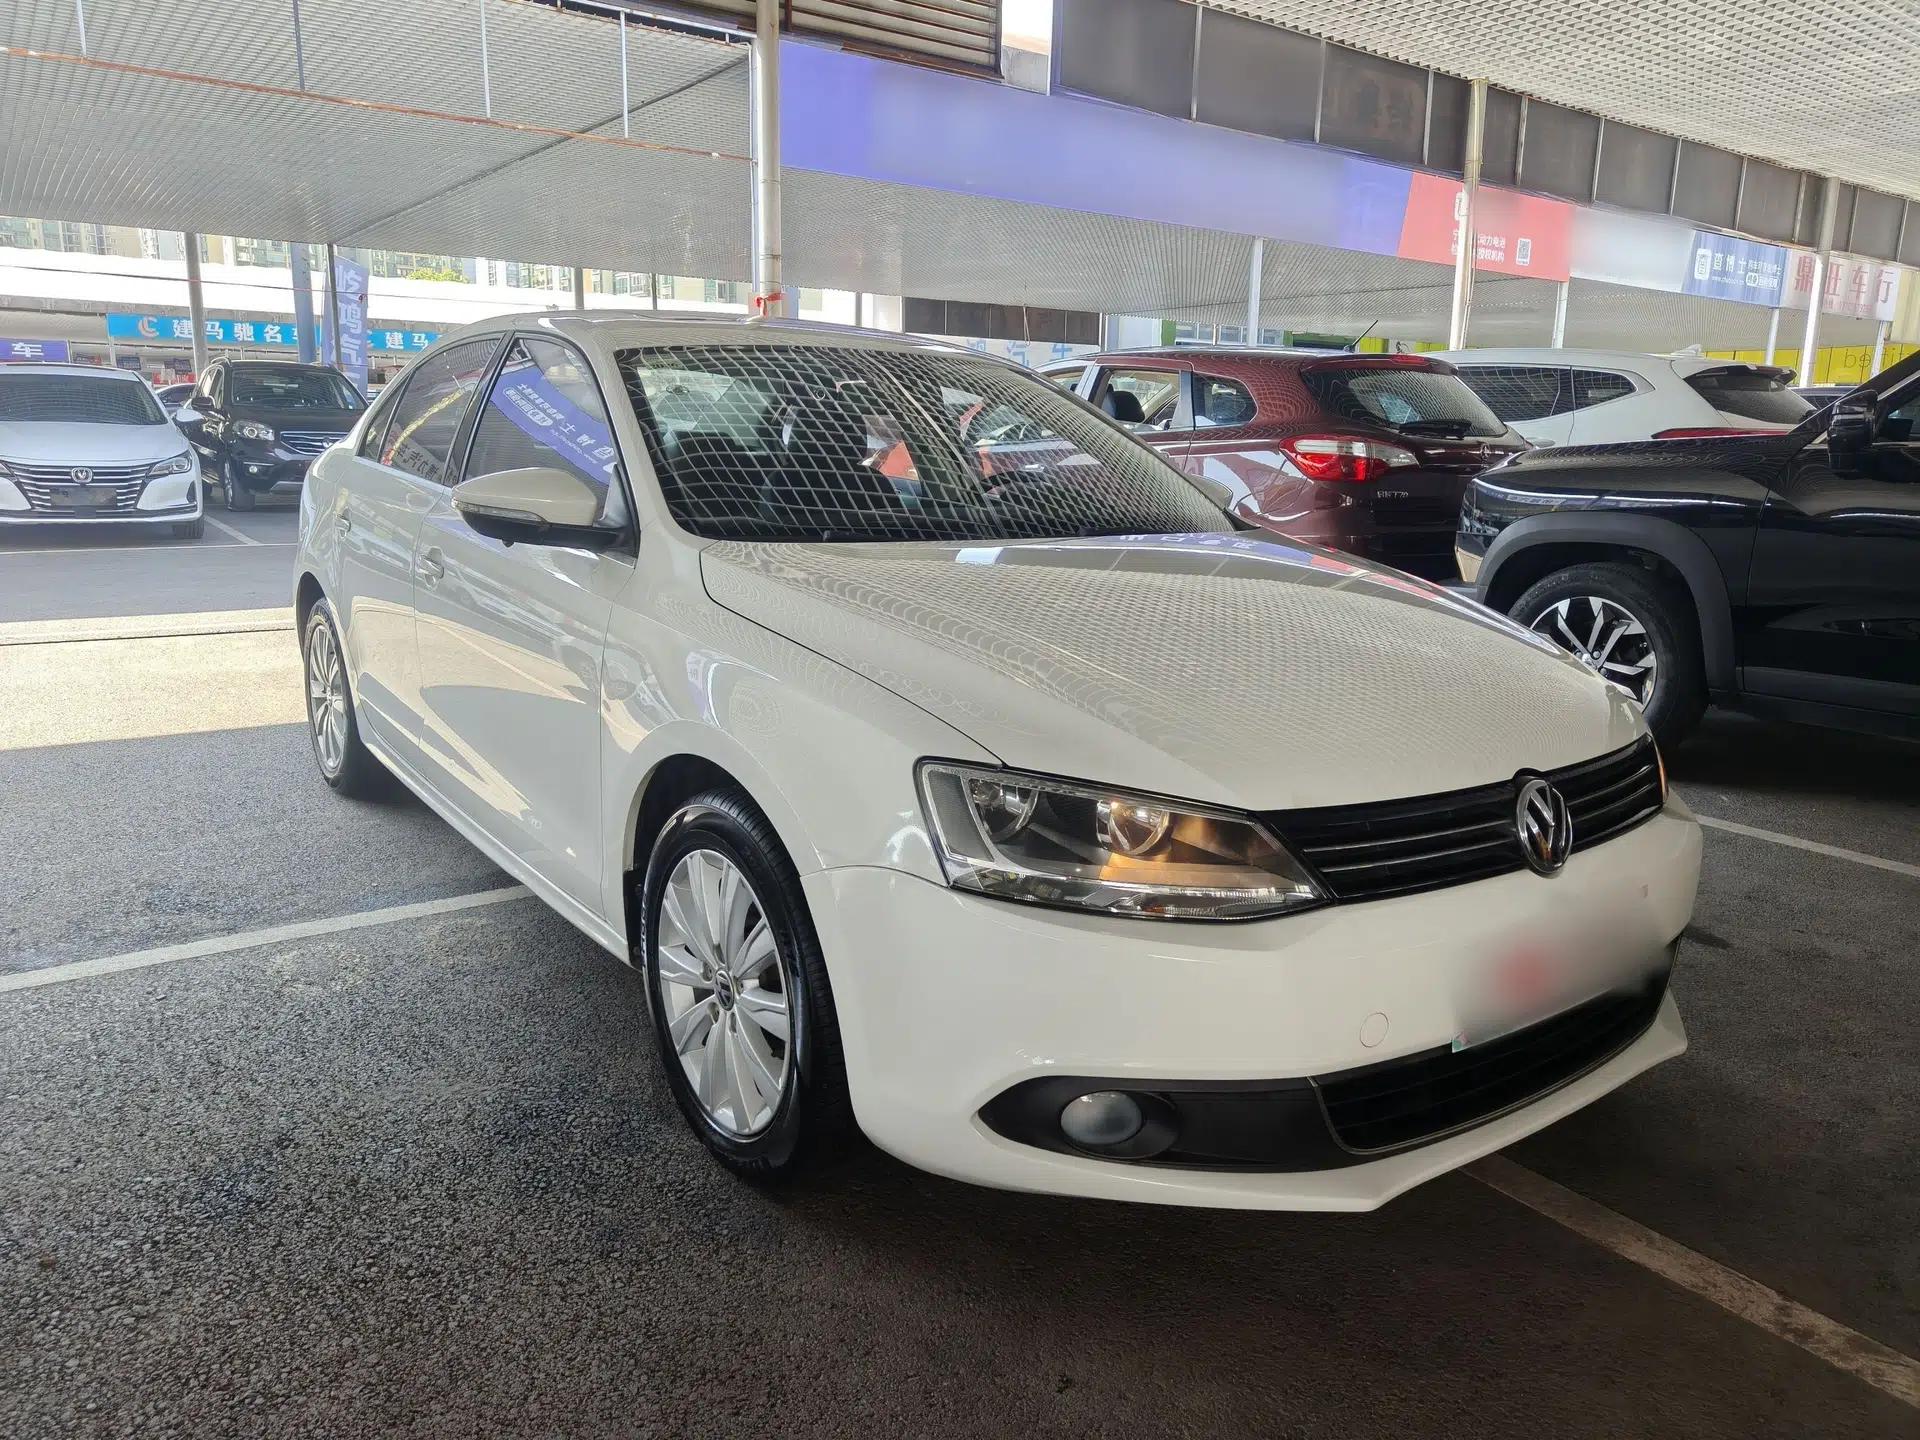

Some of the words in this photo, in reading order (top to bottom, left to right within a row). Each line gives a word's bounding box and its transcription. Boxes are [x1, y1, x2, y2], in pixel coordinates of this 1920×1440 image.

[1712, 253, 1747, 274] 查博士
[172, 319, 299, 343] 建马驰名
[385, 331, 442, 350] 建马
[12, 341, 44, 358] 车
